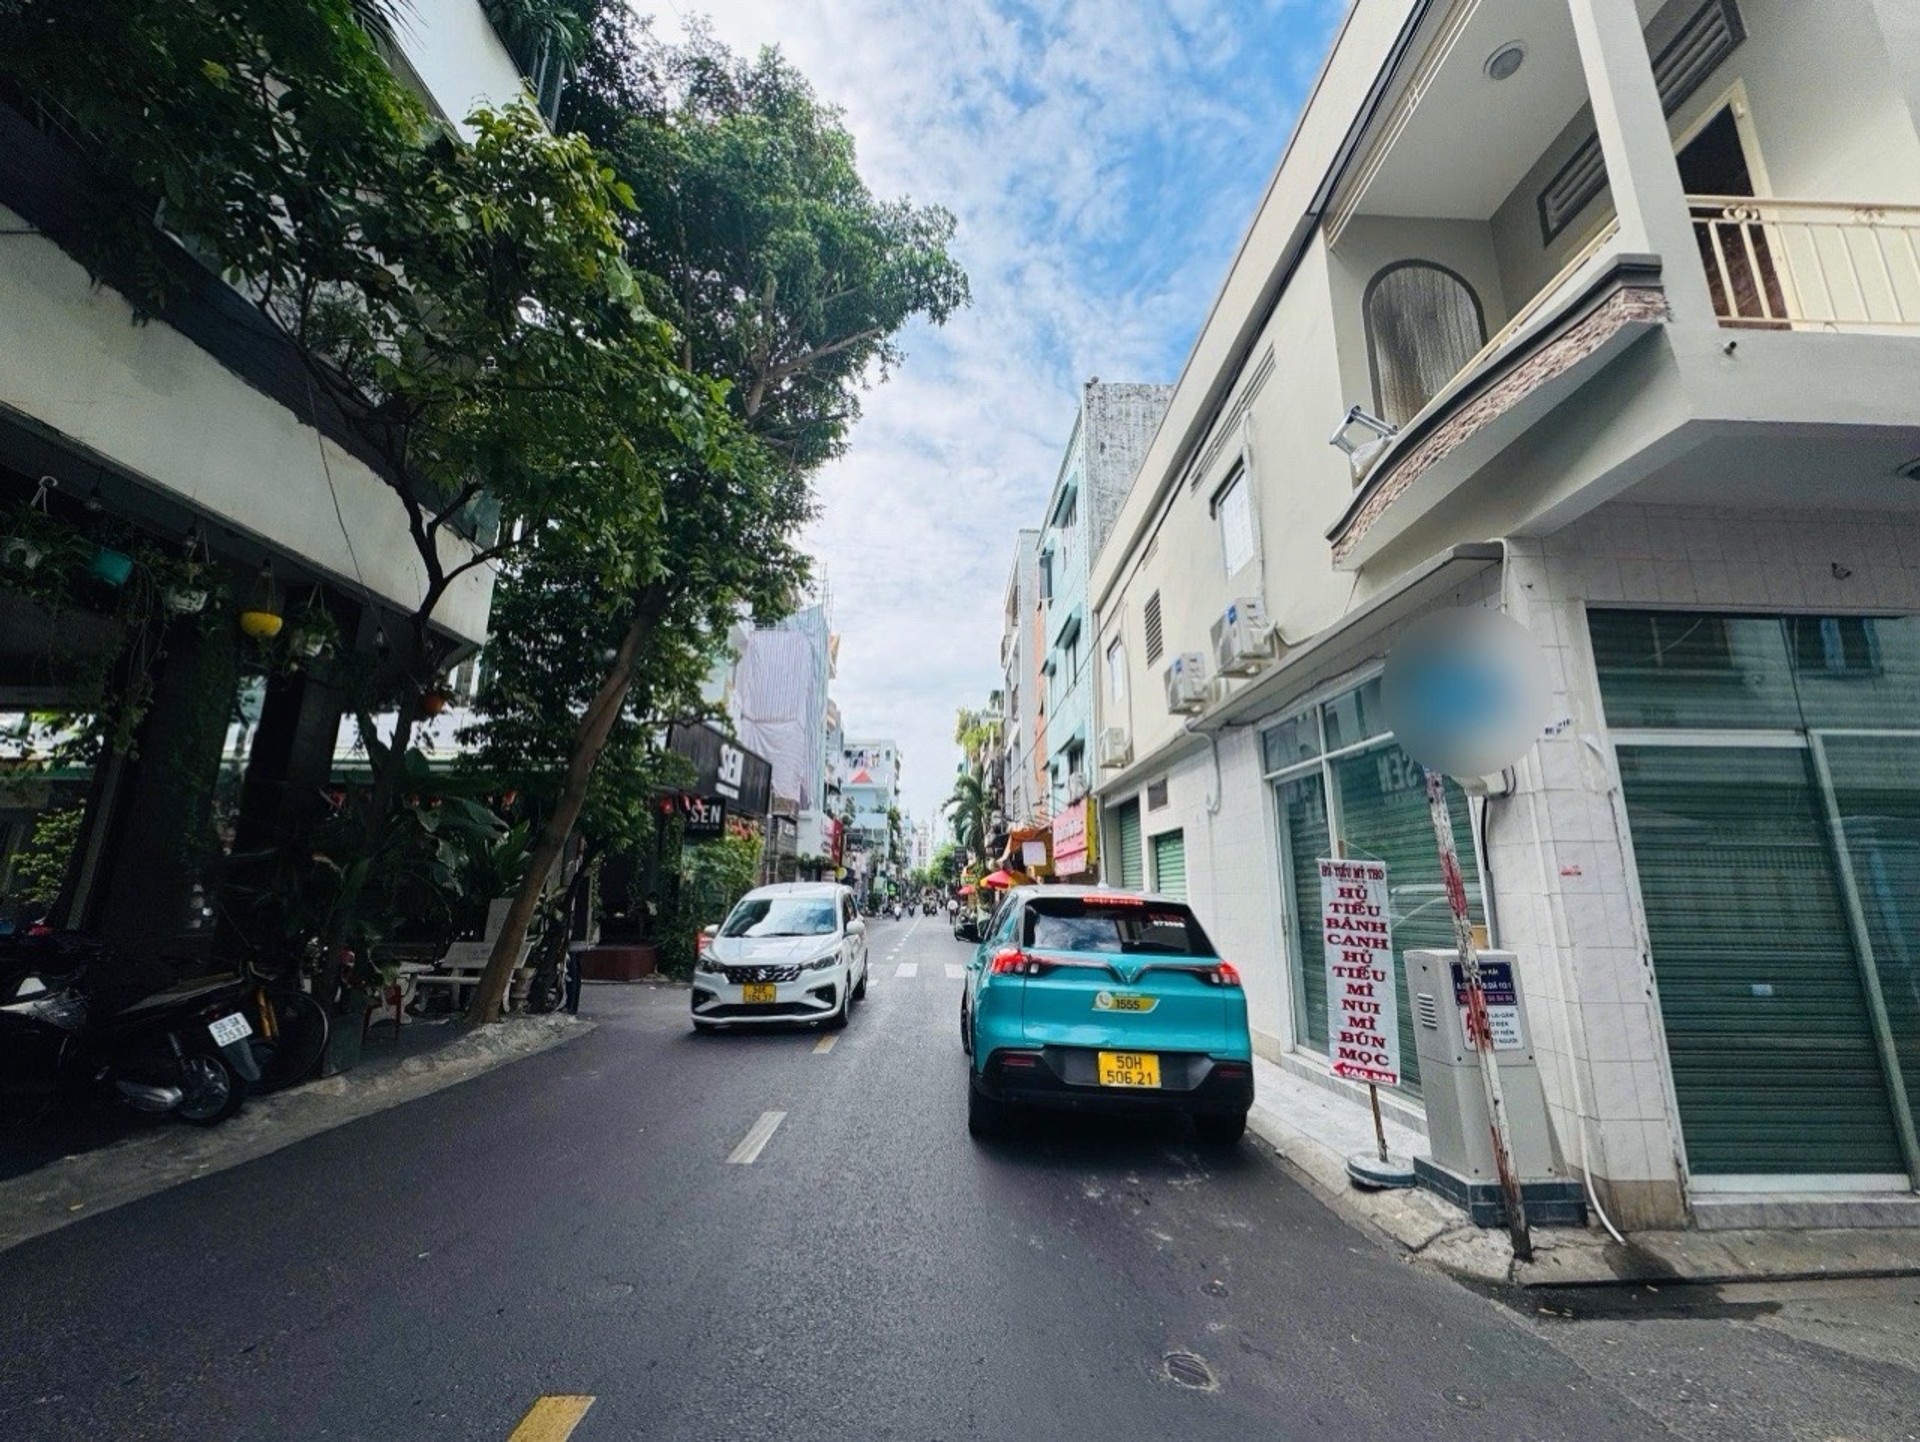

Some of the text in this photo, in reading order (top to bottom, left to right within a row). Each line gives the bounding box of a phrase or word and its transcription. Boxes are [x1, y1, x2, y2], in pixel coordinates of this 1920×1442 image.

[690, 804, 721, 824] SEN
[1338, 884, 1368, 900] HỦ
[1329, 900, 1381, 917] TIẾU
[1325, 917, 1388, 934] BÁNH
[1327, 934, 1389, 950] CANH
[1342, 949, 1374, 964] HỦ
[1332, 964, 1386, 982] TIẾU
[1346, 983, 1374, 997] MÌ
[1116, 999, 1140, 1010] 1555
[1341, 999, 1381, 1015] NUI
[1348, 1016, 1376, 1031] MÌ
[1340, 1031, 1386, 1049] BÚN
[1116, 1055, 1143, 1070] 50H
[1338, 1047, 1390, 1067] MỌC
[1107, 1070, 1153, 1085] 506.21
